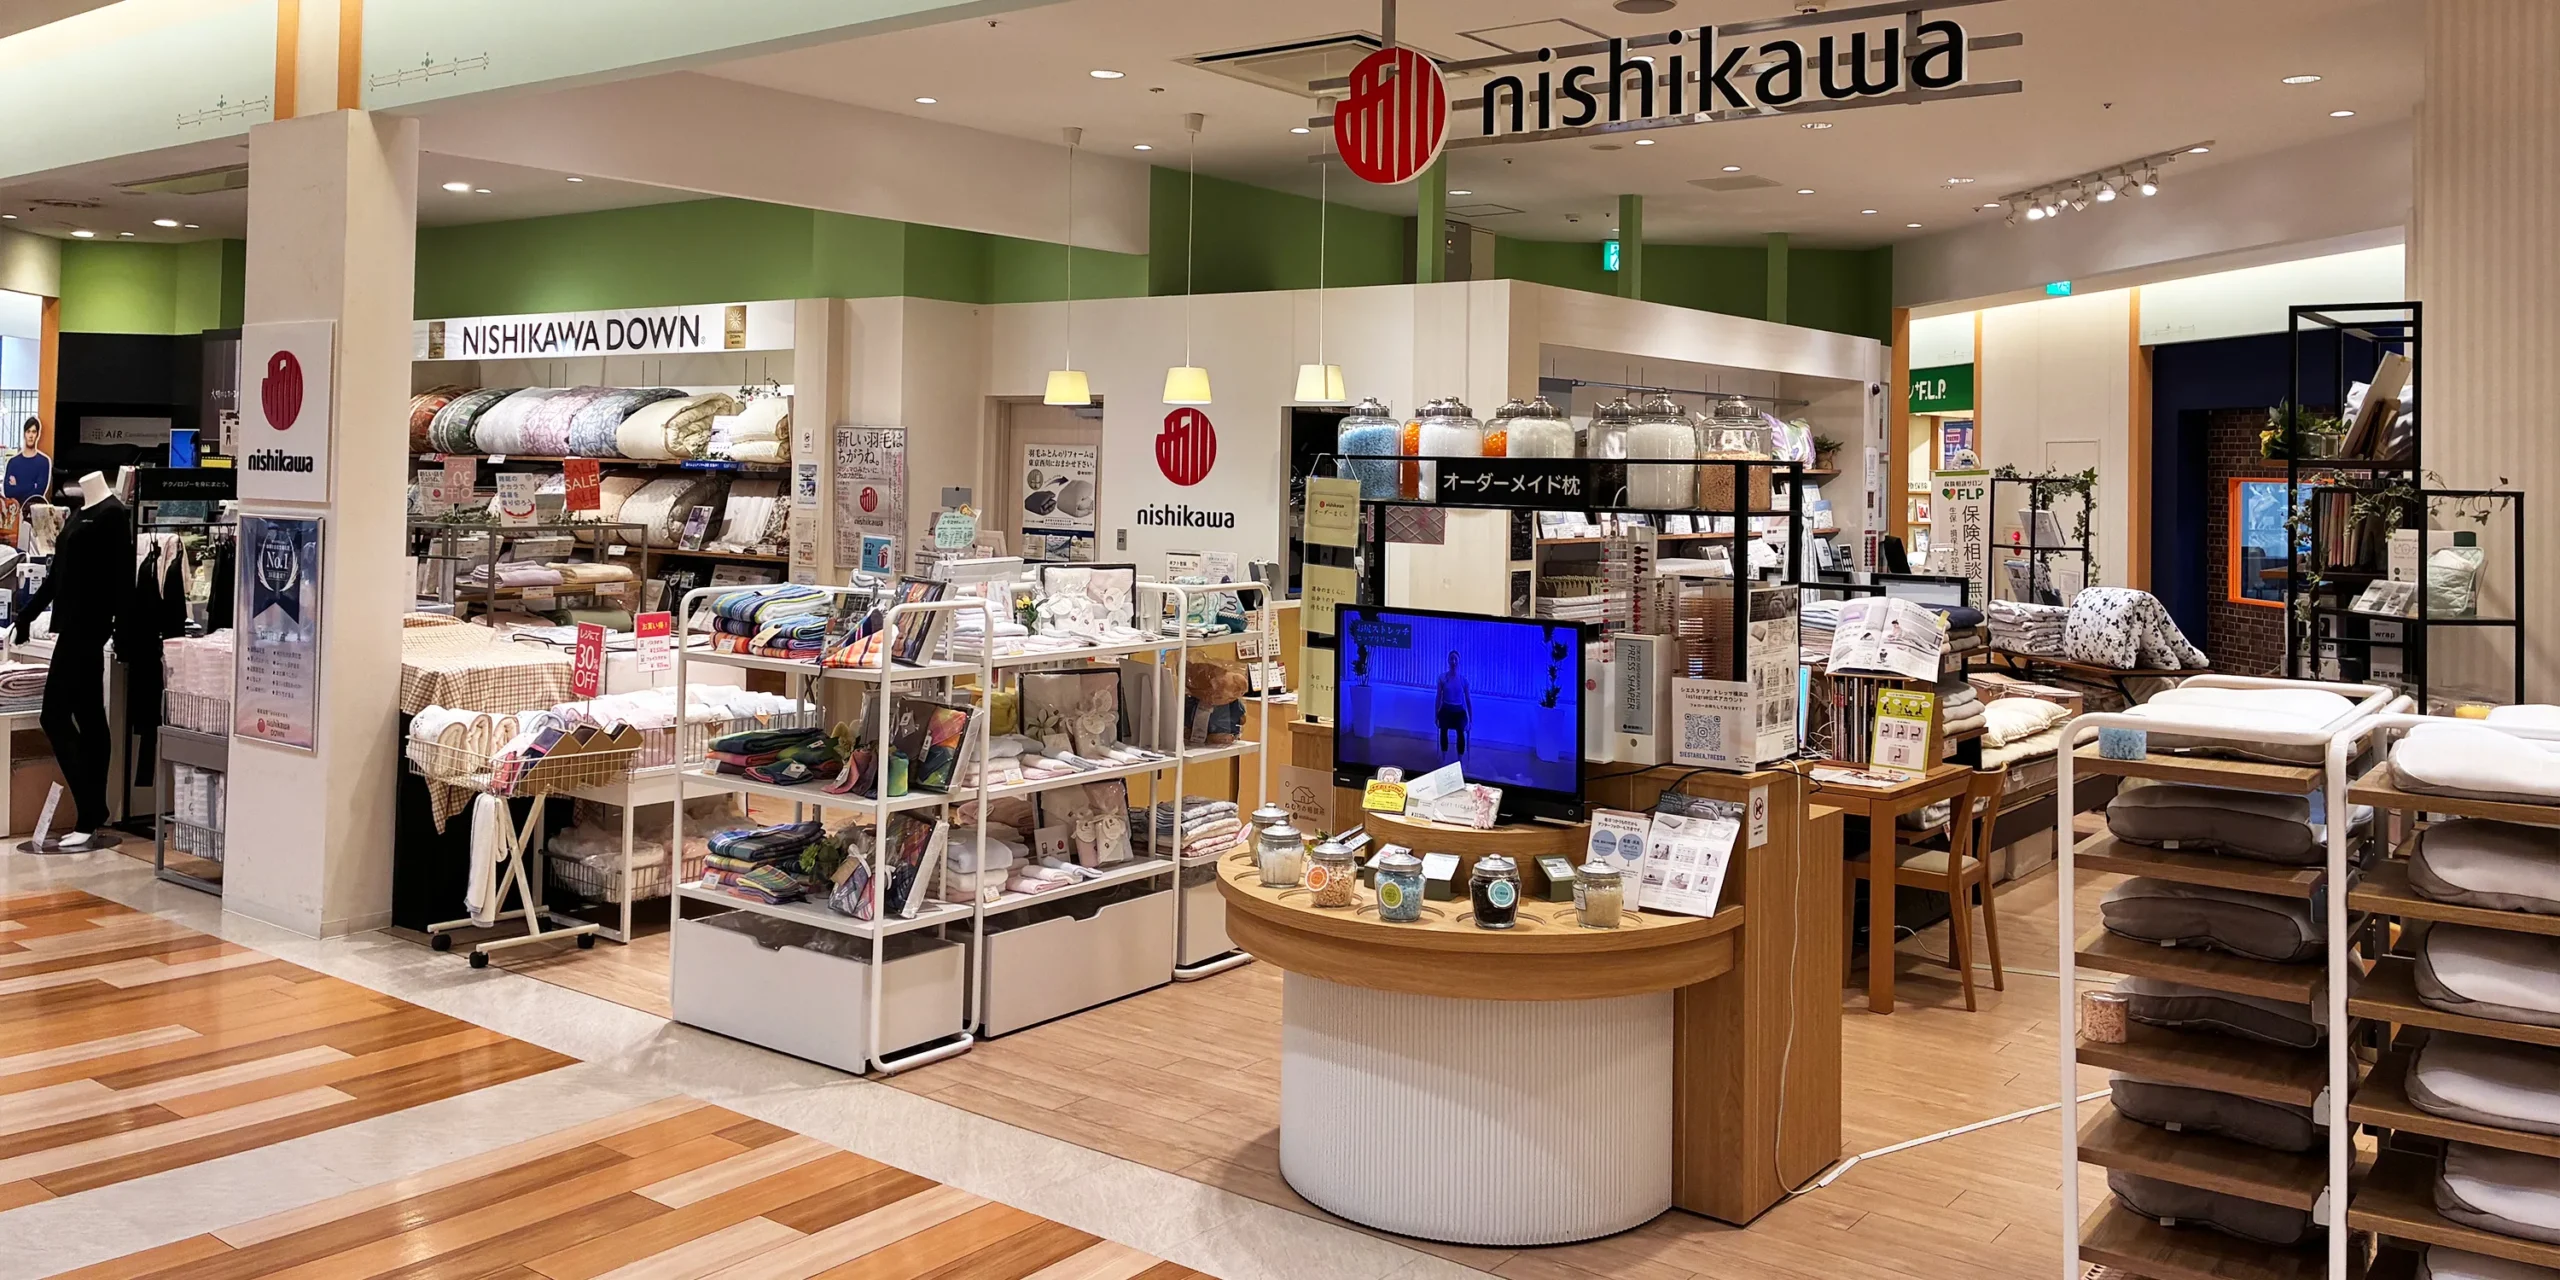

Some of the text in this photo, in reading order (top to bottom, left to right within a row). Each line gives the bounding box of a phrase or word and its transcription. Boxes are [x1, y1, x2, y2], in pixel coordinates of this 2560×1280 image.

[1482, 19, 1968, 136] nishikawa
[463, 314, 700, 355] NISHIKAWA DOWN
[105, 430, 123, 438] AIR
[837, 430, 903, 449] 新しい羽毛は
[248, 449, 314, 474] nishikawa
[837, 448, 880, 466] ちがうね。
[1028, 448, 1094, 459] 羽毛ふとんのリフォームは
[161, 480, 230, 489] テクノロジーを身にまとう。
[1443, 471, 1582, 497] オーダーメイド枕
[1944, 480, 1983, 488] 保険相談サロン
[1957, 487, 1984, 501] FLP
[1137, 503, 1236, 528] nishikawa
[265, 551, 289, 570] No.1
[580, 628, 600, 642] レジにて
[2374, 631, 2396, 639] wrap
[575, 669, 597, 691] OFF
[1627, 644, 1636, 710] PRESS SHAPER
